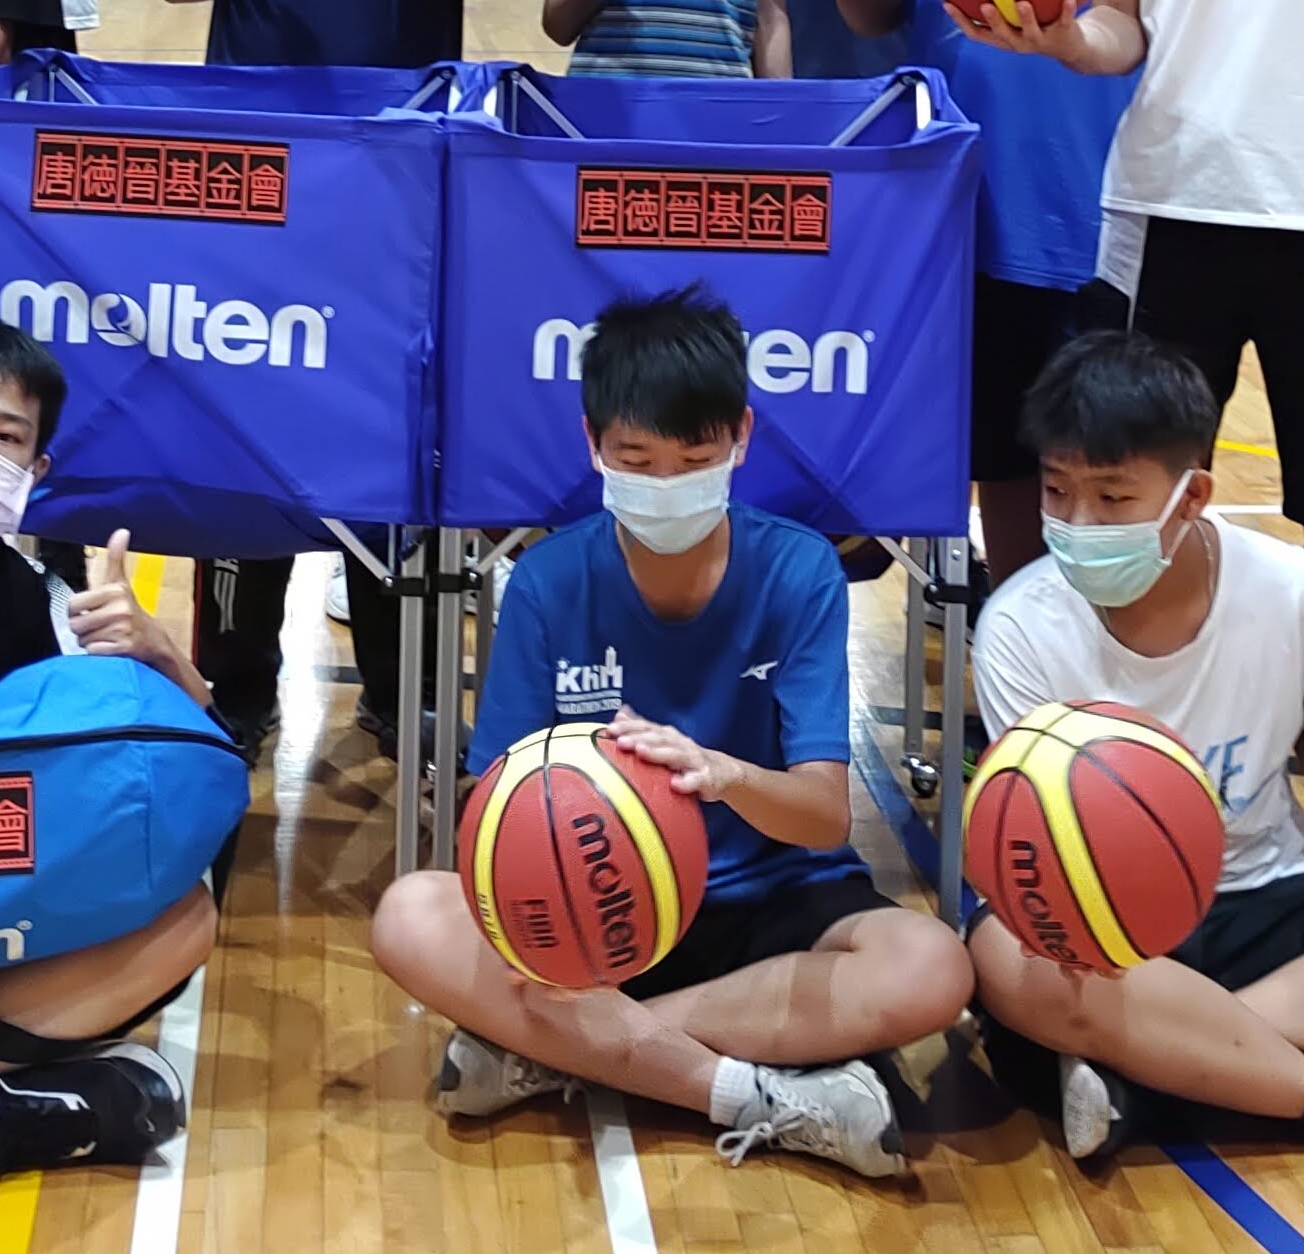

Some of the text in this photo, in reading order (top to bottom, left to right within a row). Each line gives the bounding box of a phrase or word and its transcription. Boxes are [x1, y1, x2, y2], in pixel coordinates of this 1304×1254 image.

[37, 151, 285, 209] 唐德晉基金會
[581, 187, 828, 237] 唐德晉基金會
[0, 279, 328, 368] molten
[533, 317, 869, 394] men
[572, 814, 638, 968] molten
[1009, 840, 1078, 960] molte
